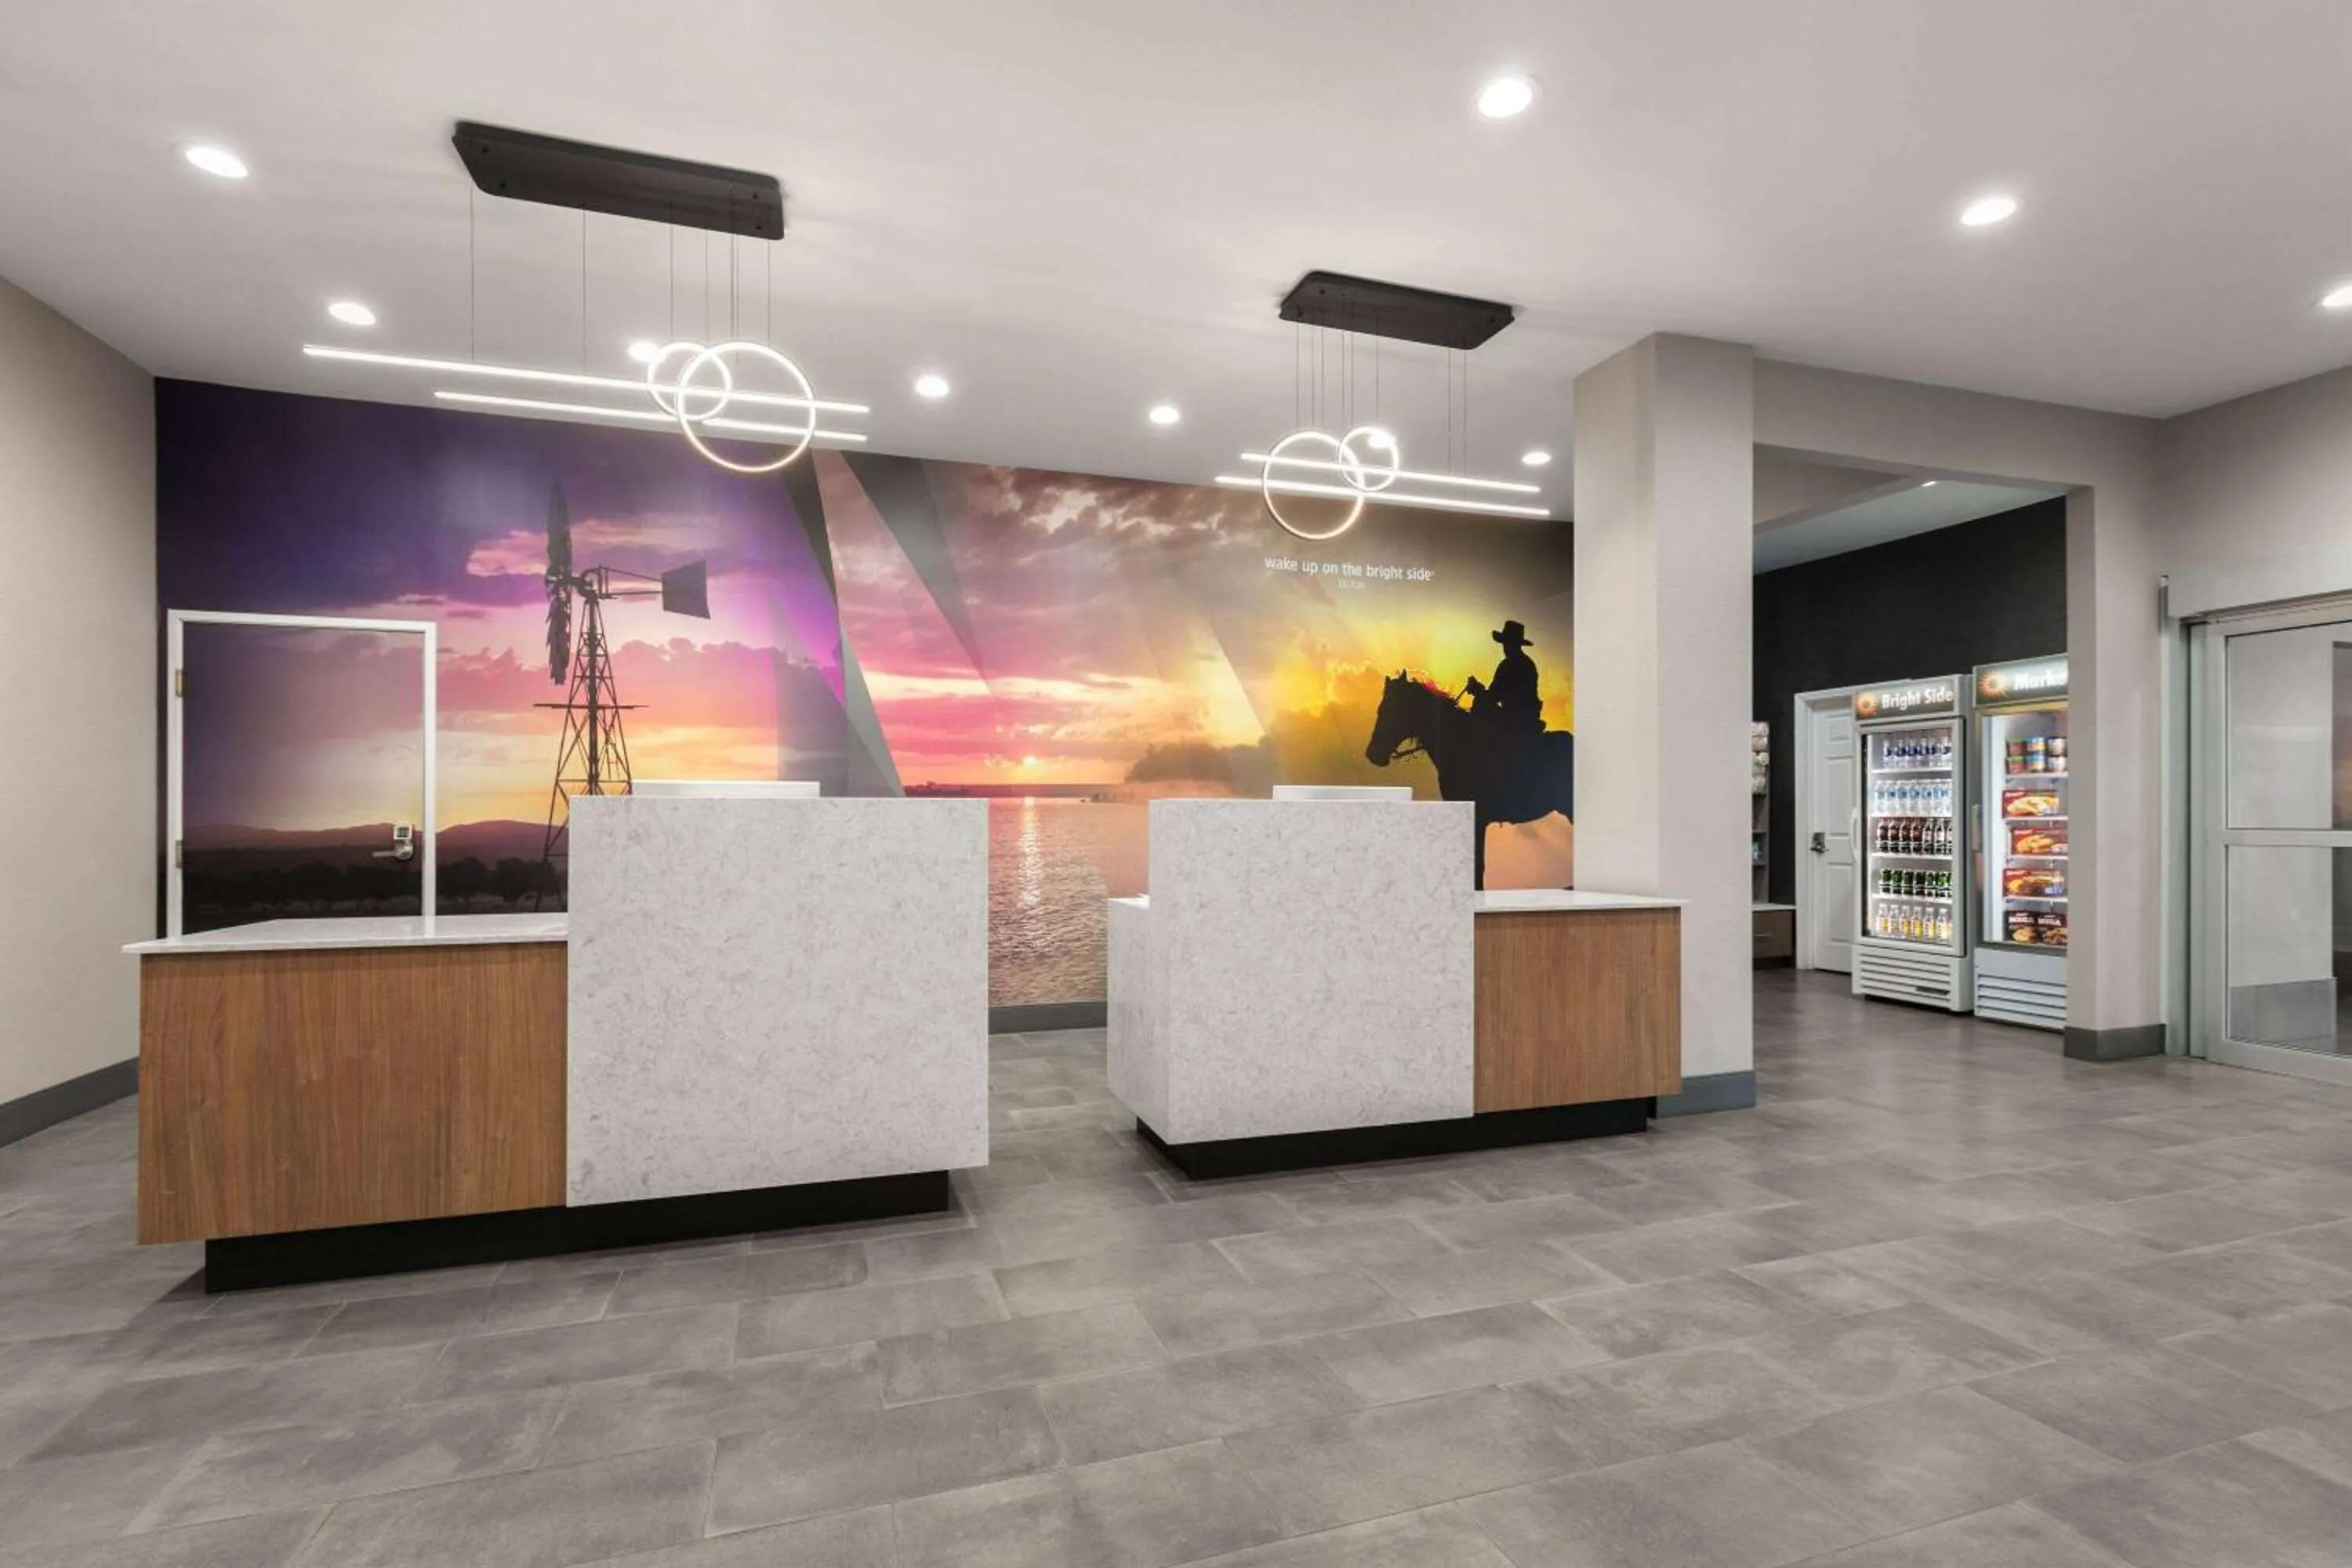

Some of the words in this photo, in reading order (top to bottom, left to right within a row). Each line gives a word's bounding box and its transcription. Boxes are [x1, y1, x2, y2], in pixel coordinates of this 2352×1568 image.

[1265, 557, 1298, 571] wake
[1302, 560, 1318, 575] up
[1323, 562, 1338, 574] on
[1342, 562, 1363, 576] the
[1367, 564, 1403, 580] bright
[2013, 670, 2068, 691] Marke
[1881, 692, 1921, 711] Bright
[1924, 686, 1954, 703] Side
